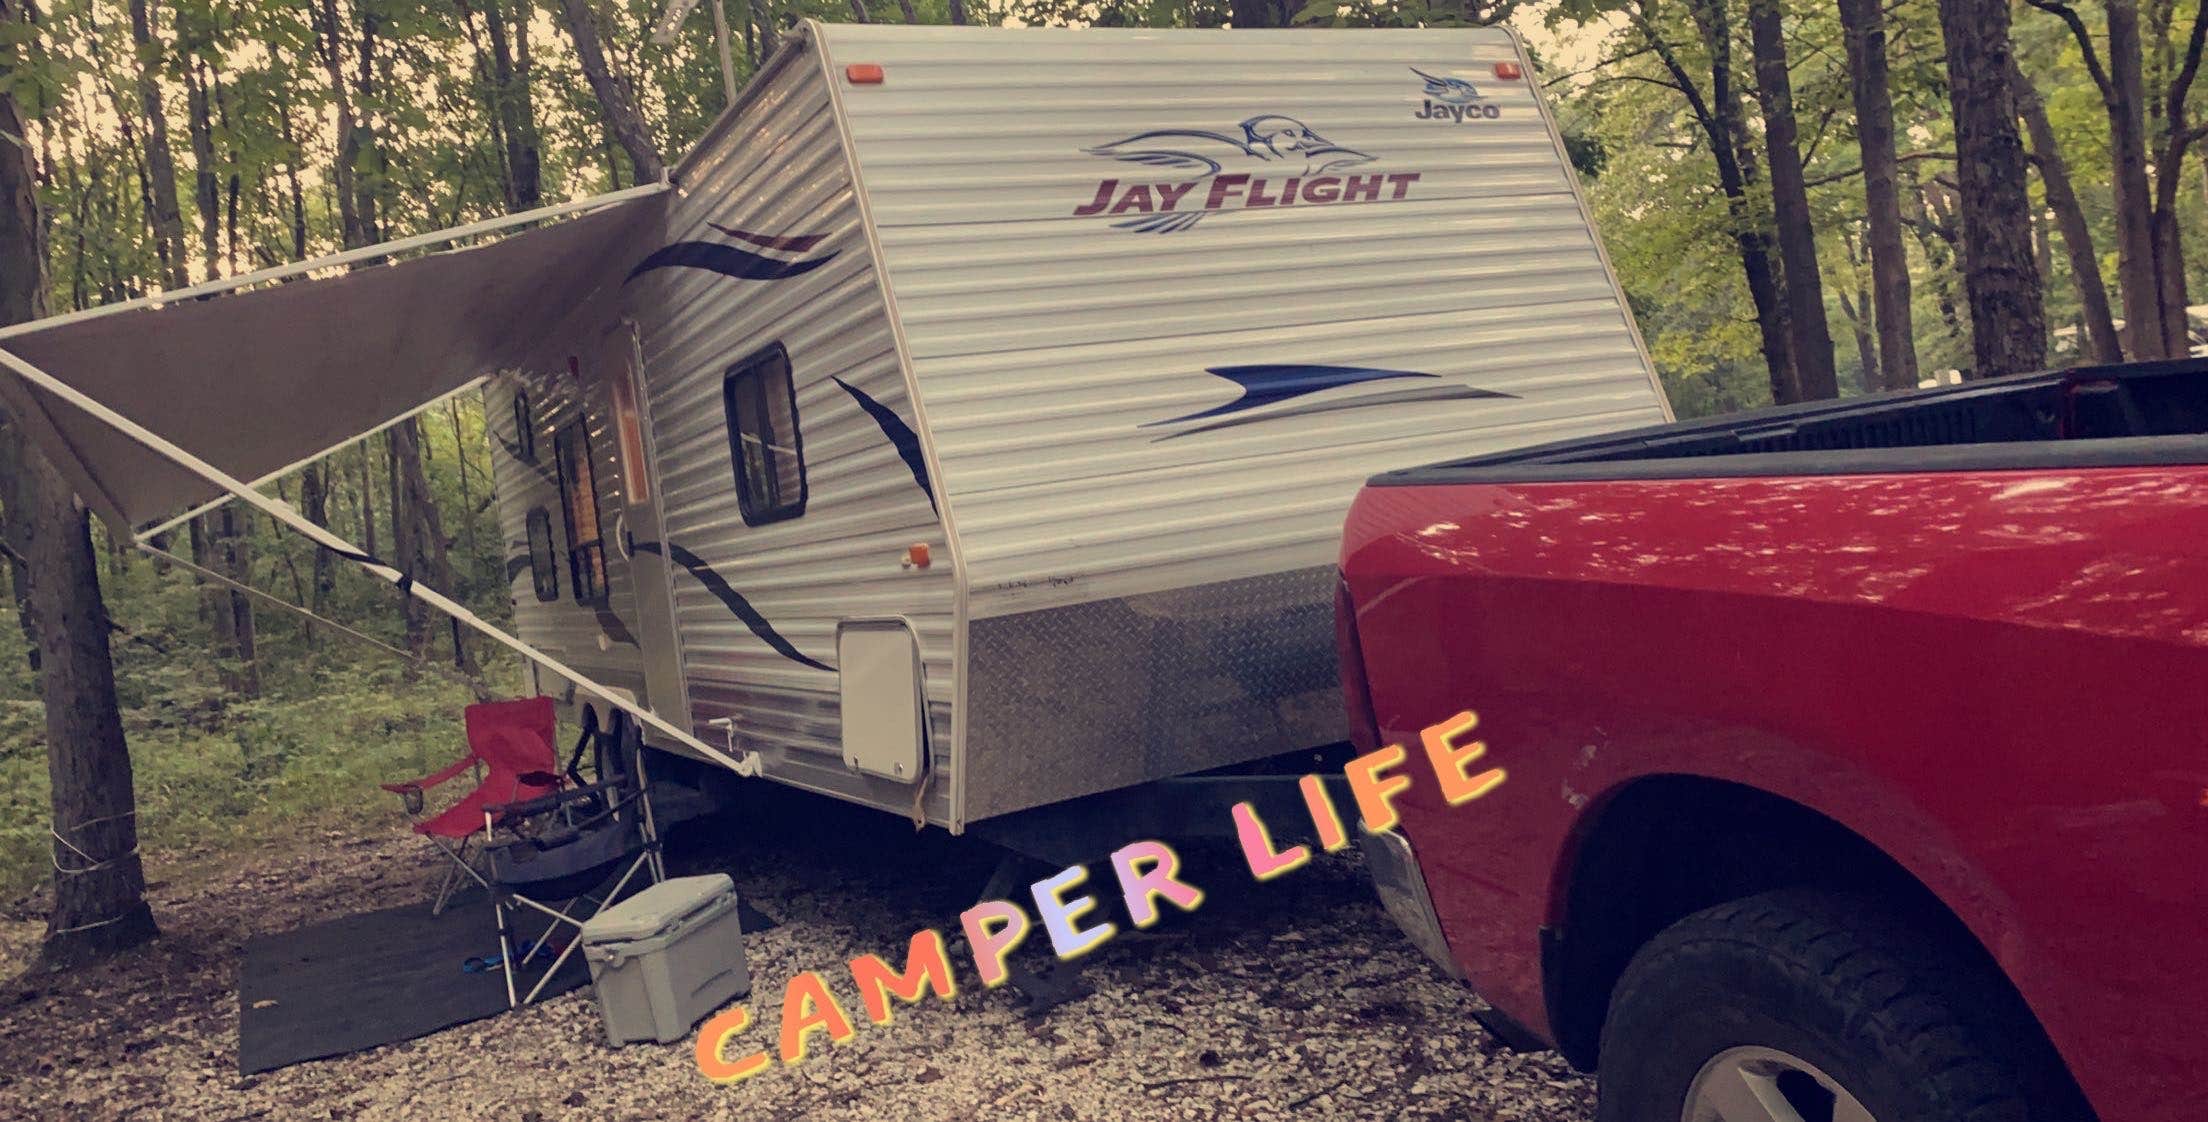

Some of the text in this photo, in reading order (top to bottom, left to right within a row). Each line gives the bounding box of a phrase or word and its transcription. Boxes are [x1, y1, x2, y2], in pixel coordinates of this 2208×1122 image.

[1414, 99, 1500, 123] Jayco
[1073, 173, 1421, 216] JAY FLIGHT
